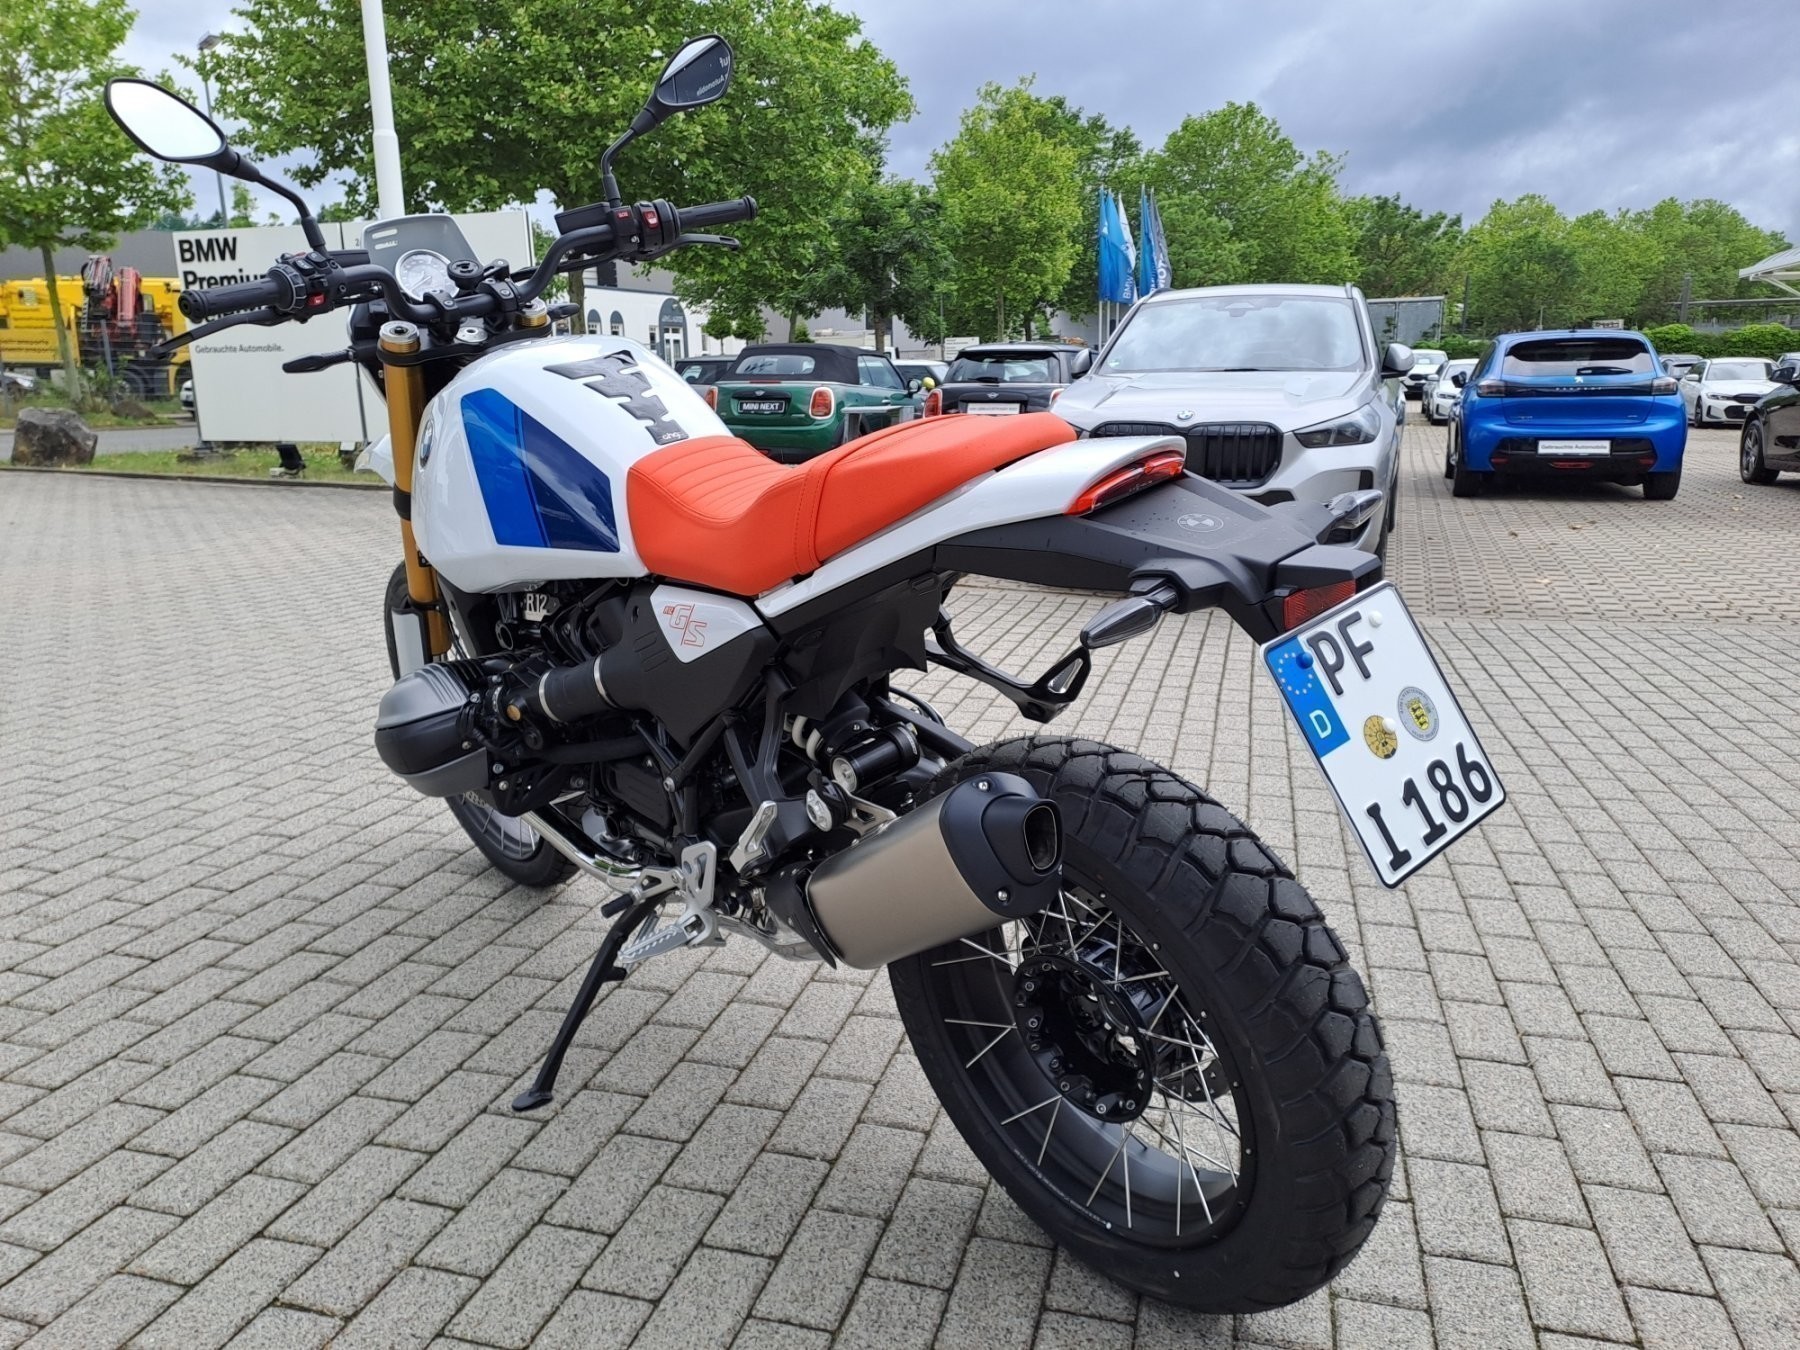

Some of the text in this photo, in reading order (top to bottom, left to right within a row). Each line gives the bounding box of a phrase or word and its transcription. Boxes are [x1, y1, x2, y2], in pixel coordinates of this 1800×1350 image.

[179, 236, 237, 263] BMW
[742, 402, 780, 410] MINI NEXT
[1306, 611, 1375, 696] PF
[1309, 709, 1332, 739] D
[1402, 741, 1493, 846] 186
